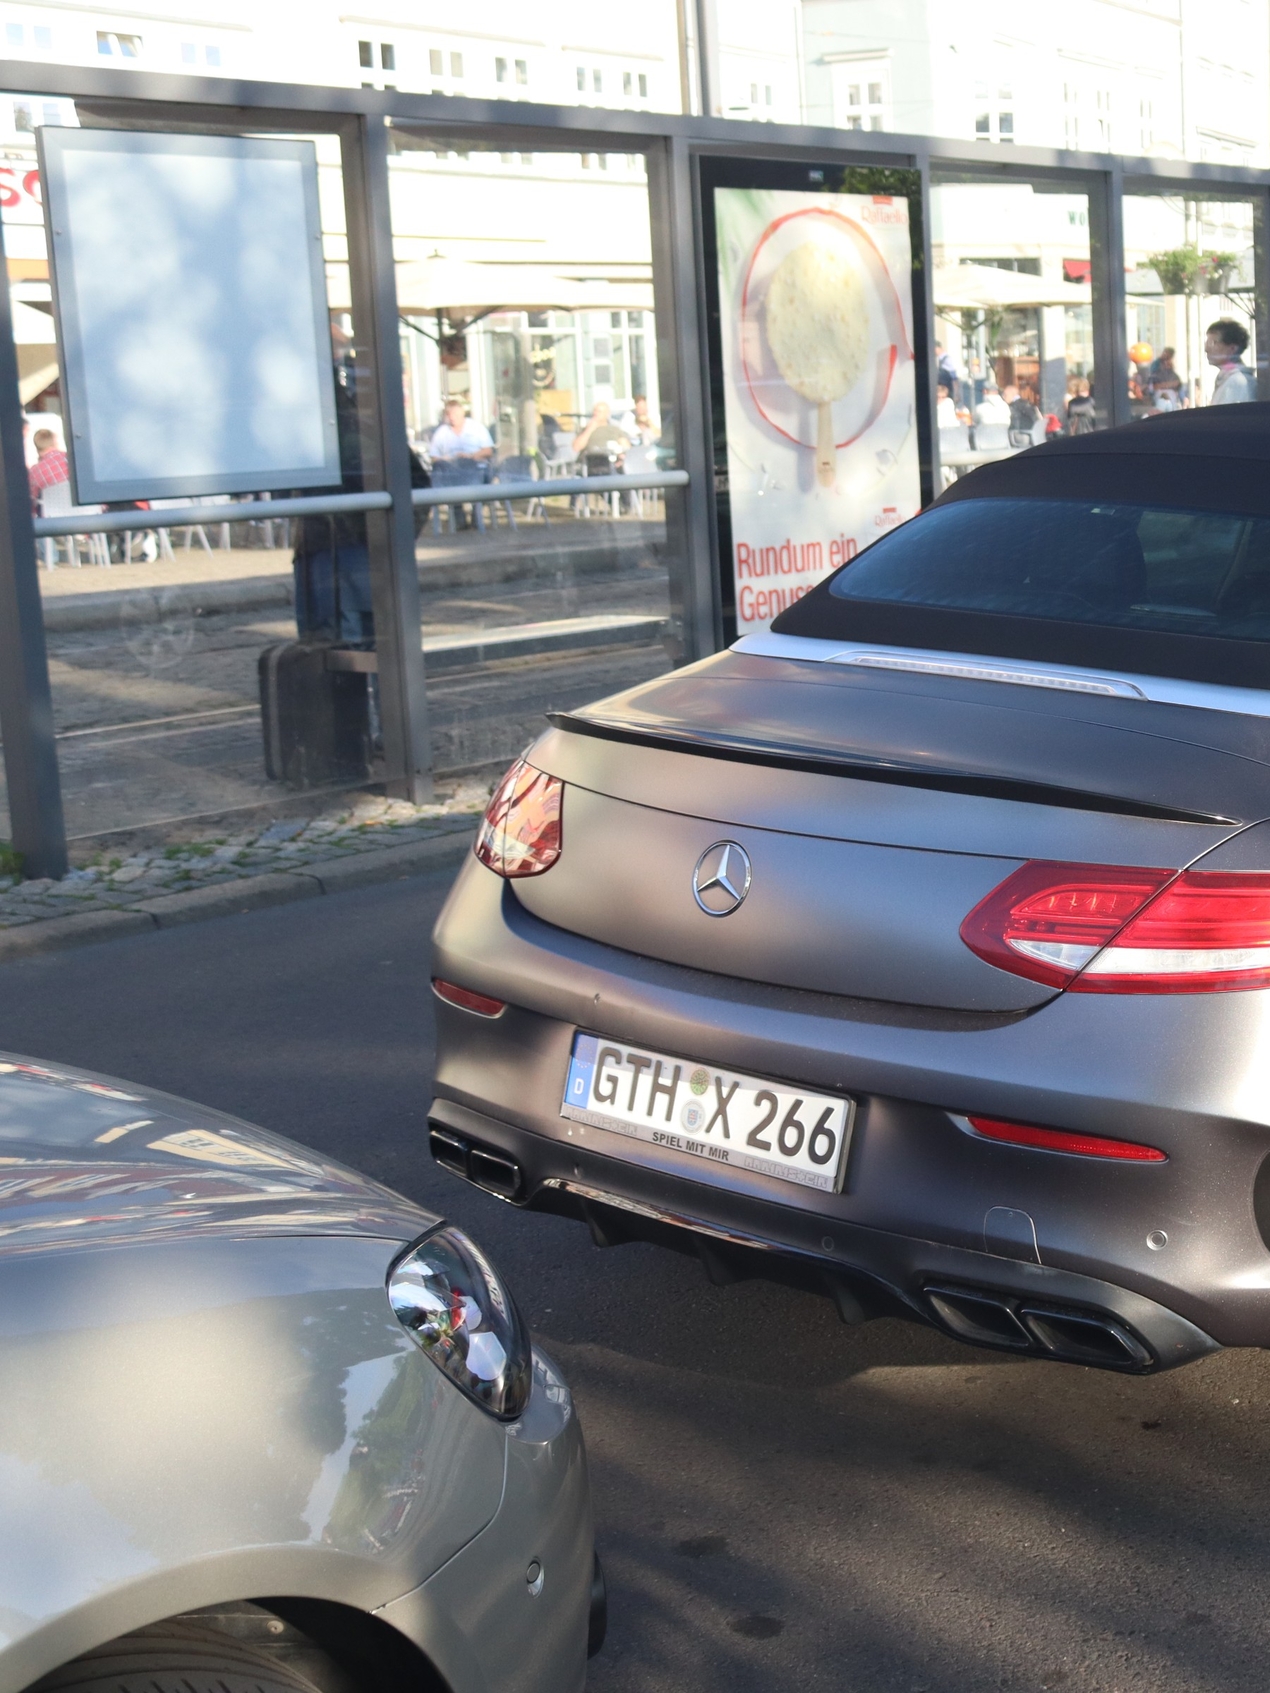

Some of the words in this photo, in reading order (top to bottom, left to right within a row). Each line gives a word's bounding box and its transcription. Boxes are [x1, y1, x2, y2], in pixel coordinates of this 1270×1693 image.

[861, 206, 908, 225] Raffaello
[736, 538, 824, 580] Rundum
[829, 533, 858, 569] ein
[574, 1078, 584, 1095] D
[592, 1046, 681, 1122] GTH
[705, 1076, 740, 1139] X
[745, 1089, 837, 1166] 266
[652, 1131, 683, 1149] SPIEL
[685, 1140, 706, 1154] MIT
[708, 1146, 730, 1161] MIR
